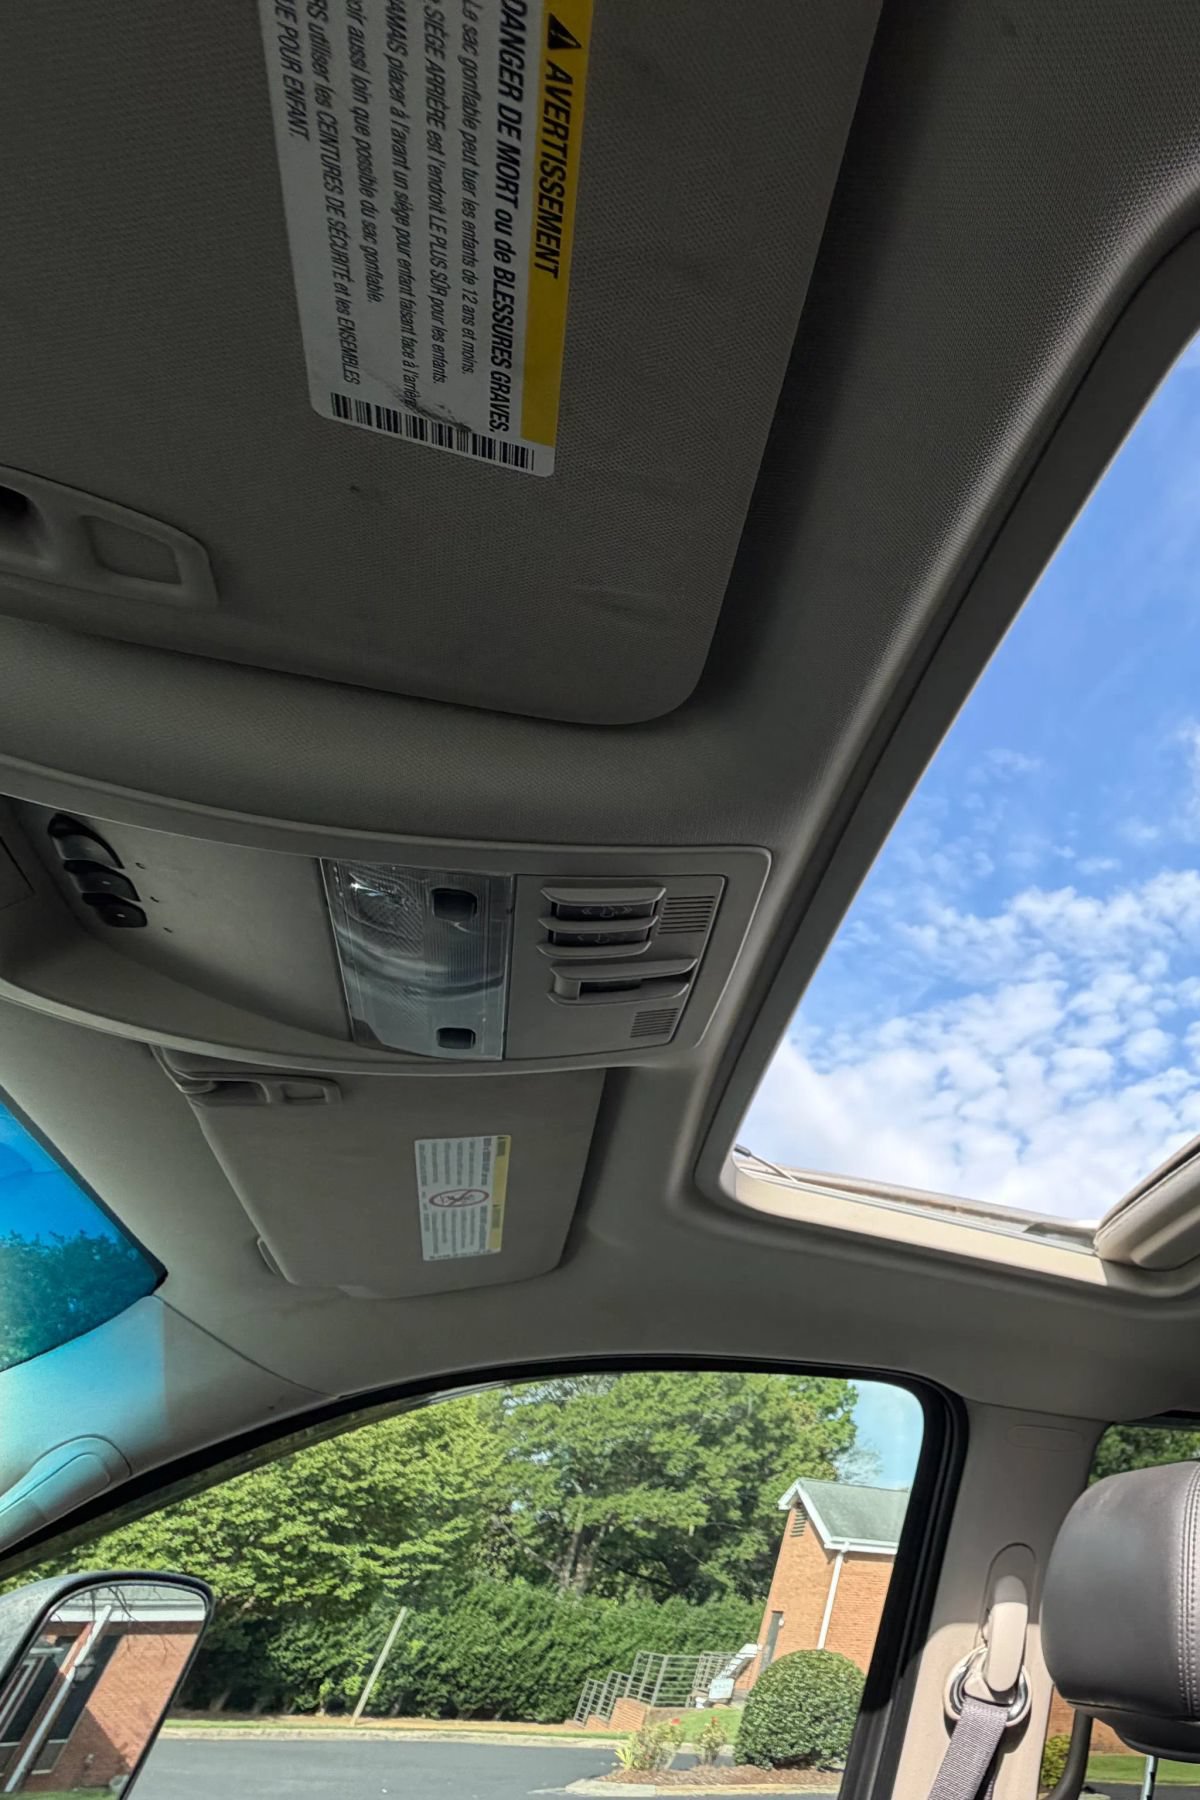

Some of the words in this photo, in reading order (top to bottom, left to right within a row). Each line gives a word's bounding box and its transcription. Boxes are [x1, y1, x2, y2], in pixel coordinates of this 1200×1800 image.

[385, 0, 408, 57] AMAIS
[424, 5, 450, 61] SIÈGE
[462, 23, 479, 56] sac
[277, 21, 303, 75] POUR
[308, 22, 332, 83] utiliser
[347, 25, 371, 75] aussi
[498, 0, 528, 103] DANGER
[314, 81, 336, 110] les
[350, 72, 373, 104] loin
[383, 52, 409, 107] placer
[425, 57, 451, 131] ARRIÈRE
[457, 54, 482, 130] gonflable
[283, 74, 310, 142] ENFANT.
[349, 105, 371, 137] que
[390, 106, 411, 120] à
[496, 102, 523, 142] DE
[316, 109, 345, 195] CEINTURES
[391, 119, 412, 171] l'avant
[427, 130, 446, 156] est
[457, 128, 480, 167] peut
[352, 135, 378, 199] possible
[392, 169, 409, 190] un
[427, 155, 447, 214] l'endroit
[462, 167, 480, 198] tuer
[495, 139, 521, 210] MORT
[534, 59, 573, 279] AVERTISSEMENT
[325, 195, 346, 219] DE
[360, 199, 380, 220] du
[391, 190, 414, 227] siège
[429, 213, 448, 235] LE
[462, 197, 480, 219] les
[494, 208, 513, 236] ou
[327, 217, 355, 284] SÉCURITÉ
[361, 219, 377, 246] sac
[392, 225, 412, 260] pour
[462, 219, 480, 268] enfants
[430, 233, 448, 270] PLUS
[493, 238, 517, 265] de
[334, 281, 352, 298] et
[359, 244, 384, 303] gonflable.
[397, 258, 416, 298] enfant
[430, 269, 452, 298] SÛR
[462, 268, 479, 286] de
[335, 296, 352, 316] les
[427, 295, 446, 326] pour
[462, 288, 479, 305] 12
[400, 296, 417, 336] faisant
[462, 304, 476, 327] ans
[462, 327, 477, 341] et
[490, 265, 516, 370] BLESSURES
[338, 316, 361, 385] ENSEMBLES
[401, 335, 418, 360] face
[431, 325, 449, 344] les
[403, 359, 420, 368] à
[432, 343, 449, 384] enfants.
[462, 339, 478, 375] moins.
[488, 370, 512, 433] GRAVES.
